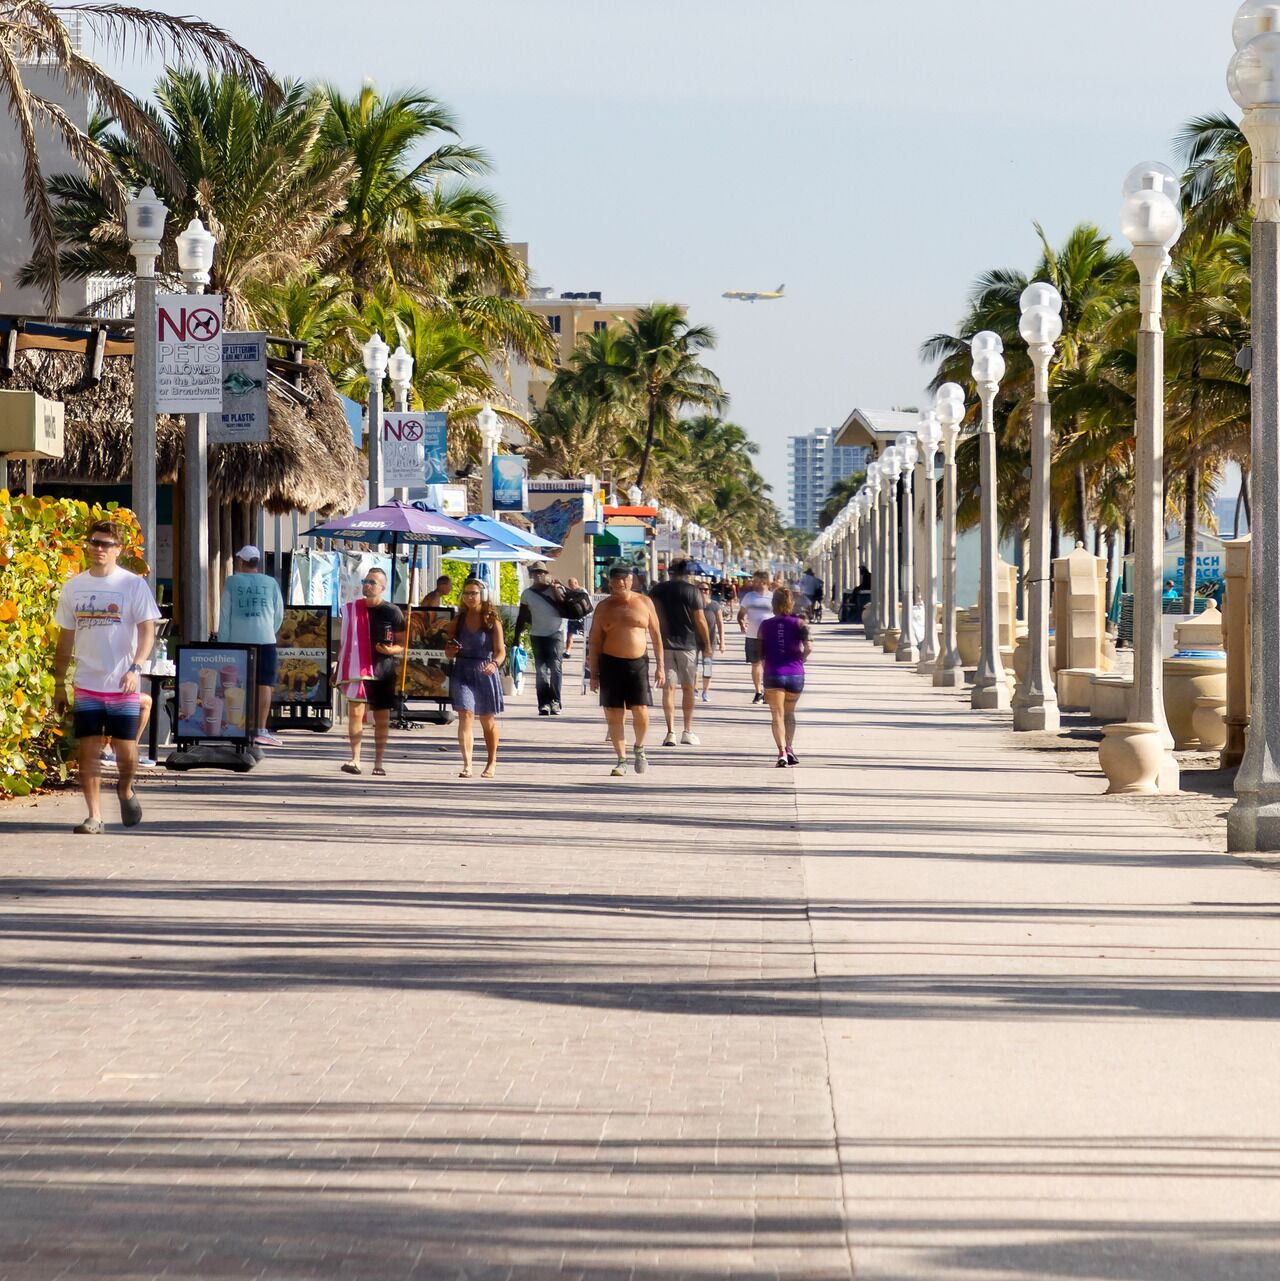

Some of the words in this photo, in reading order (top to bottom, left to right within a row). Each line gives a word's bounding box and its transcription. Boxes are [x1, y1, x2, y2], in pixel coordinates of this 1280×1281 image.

[159, 308, 220, 342] NO
[159, 343, 220, 363] PETS
[230, 345, 257, 354] LITTERING
[160, 364, 220, 375] ALLOWED
[172, 386, 220, 396] Broadwalk
[231, 413, 255, 422] PLASTIC
[384, 419, 423, 441] NO
[1177, 556, 1220, 566] BACH
[1176, 568, 1220, 577] SACK
[237, 584, 267, 595] SALT
[238, 597, 267, 608] LIFE
[191, 654, 236, 663] smoothies
